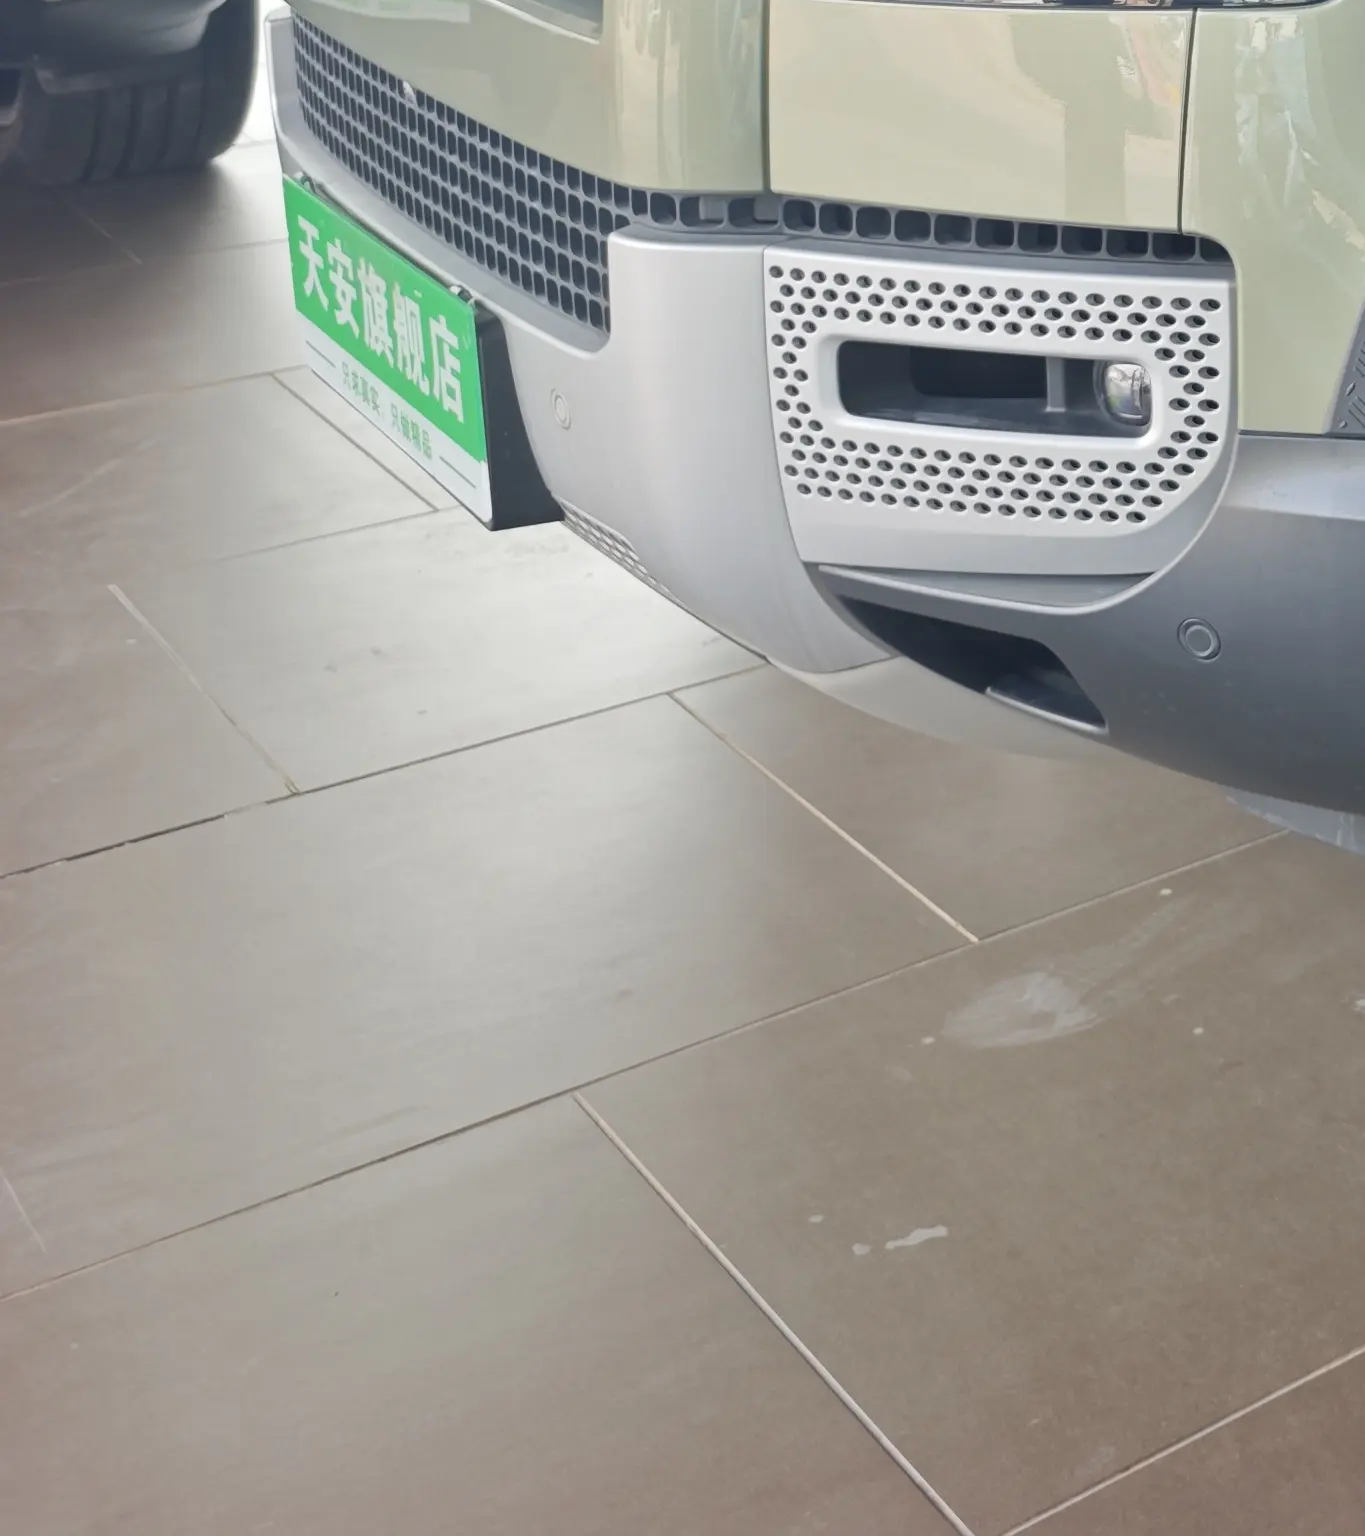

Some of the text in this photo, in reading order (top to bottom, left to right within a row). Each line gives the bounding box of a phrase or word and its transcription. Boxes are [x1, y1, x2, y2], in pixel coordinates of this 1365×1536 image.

[298, 214, 464, 423] 天安旗舰店
